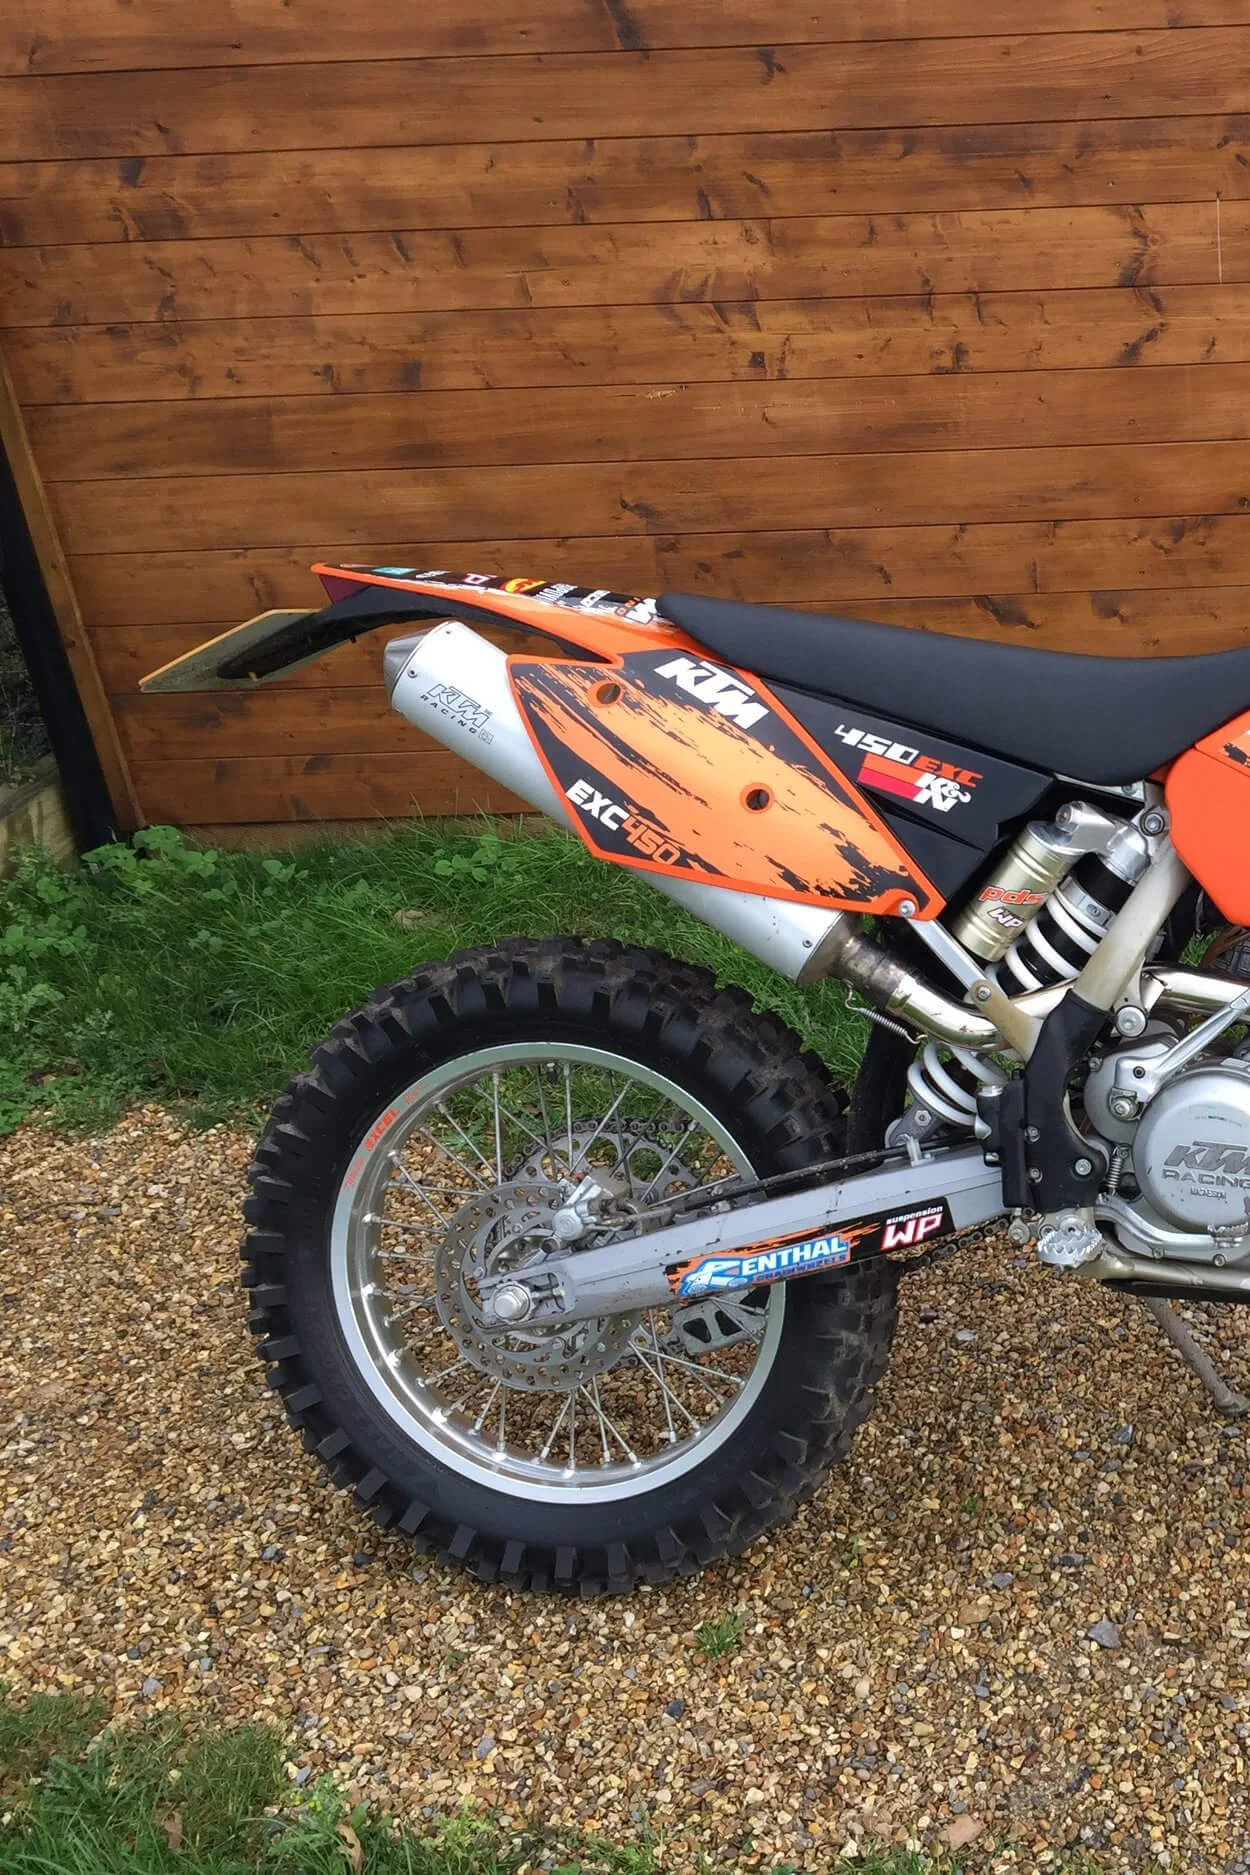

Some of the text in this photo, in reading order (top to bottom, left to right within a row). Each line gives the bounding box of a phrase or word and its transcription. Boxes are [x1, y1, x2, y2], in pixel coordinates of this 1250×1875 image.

[426, 683, 490, 728] KTM
[653, 657, 770, 730] KTM
[420, 694, 477, 734] RACING
[987, 906, 1024, 928] WP
[880, 1212, 945, 1251] WP
[886, 1205, 944, 1224] suspension
